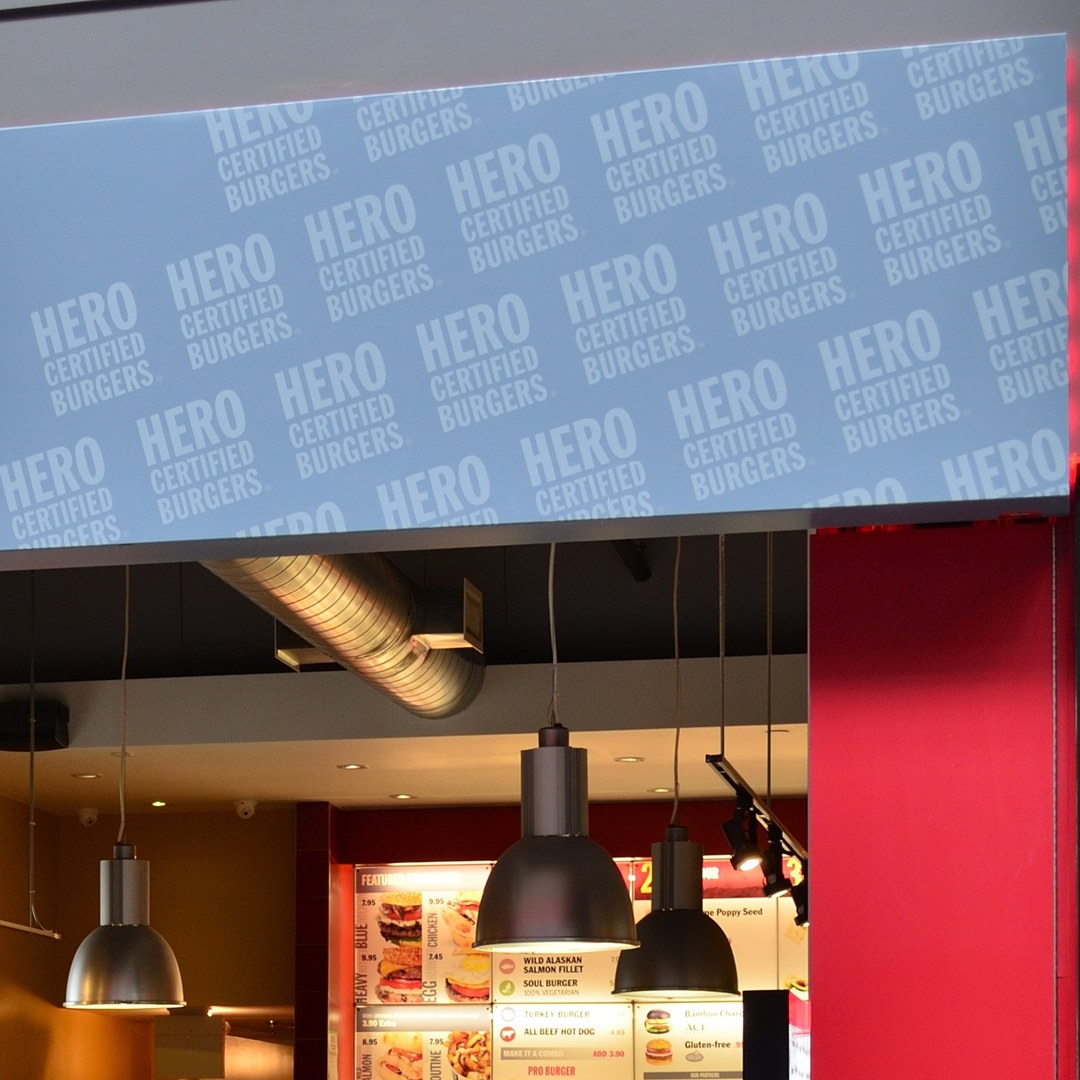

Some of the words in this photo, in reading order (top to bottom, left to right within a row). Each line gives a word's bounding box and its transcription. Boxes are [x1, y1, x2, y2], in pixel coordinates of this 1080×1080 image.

[590, 81, 709, 163] HERO
[445, 133, 561, 213] HERO
[605, 134, 718, 193] CERTIFIED
[858, 140, 983, 224] HERO
[303, 183, 417, 262] HERO
[459, 184, 570, 243] CERTIFIED
[612, 163, 727, 224] BURGERS
[467, 213, 579, 273] BURGERS
[707, 192, 830, 275] HERO
[874, 194, 993, 254] CERTIFIED
[166, 233, 276, 311] HERO
[318, 234, 425, 292] CERTIFIED
[559, 243, 678, 325] HERO
[722, 246, 838, 305] CERTIFIED
[882, 224, 1002, 287] BURGERS
[30, 282, 138, 358] HERO
[179, 283, 285, 340] CERTIFIED
[325, 263, 435, 322] BURGERS
[729, 276, 847, 337] BURGERS
[186, 312, 293, 370] BURGERS
[415, 293, 531, 372] HERO
[575, 296, 687, 354] CERTIFIED
[818, 308, 943, 392] HERO
[43, 332, 146, 387] CERTIFIED
[273, 342, 387, 419] HERO
[429, 345, 539, 401] CERTIFIED
[582, 326, 696, 386] BURGERS
[50, 360, 154, 417] BURGERS
[436, 374, 549, 433] BURGERS
[668, 358, 788, 440] HERO
[833, 362, 951, 421] CERTIFIED
[136, 389, 246, 465] HERO
[288, 393, 395, 448] CERTIFIED
[682, 411, 797, 470] CERTIFIED
[841, 393, 960, 454] BURGERS
[150, 439, 254, 495] CERTIFIED
[295, 422, 404, 479] BURGERS
[690, 442, 807, 502] BURGERS
[156, 468, 262, 525] BURGERS
[356, 924, 367, 948] BLUE
[428, 912, 437, 948] CHICKEN
[717, 908, 740, 917] Poppy
[422, 980, 437, 1003] EGG
[528, 1067, 543, 1075] PRO
[546, 1066, 575, 1076] BURGER
